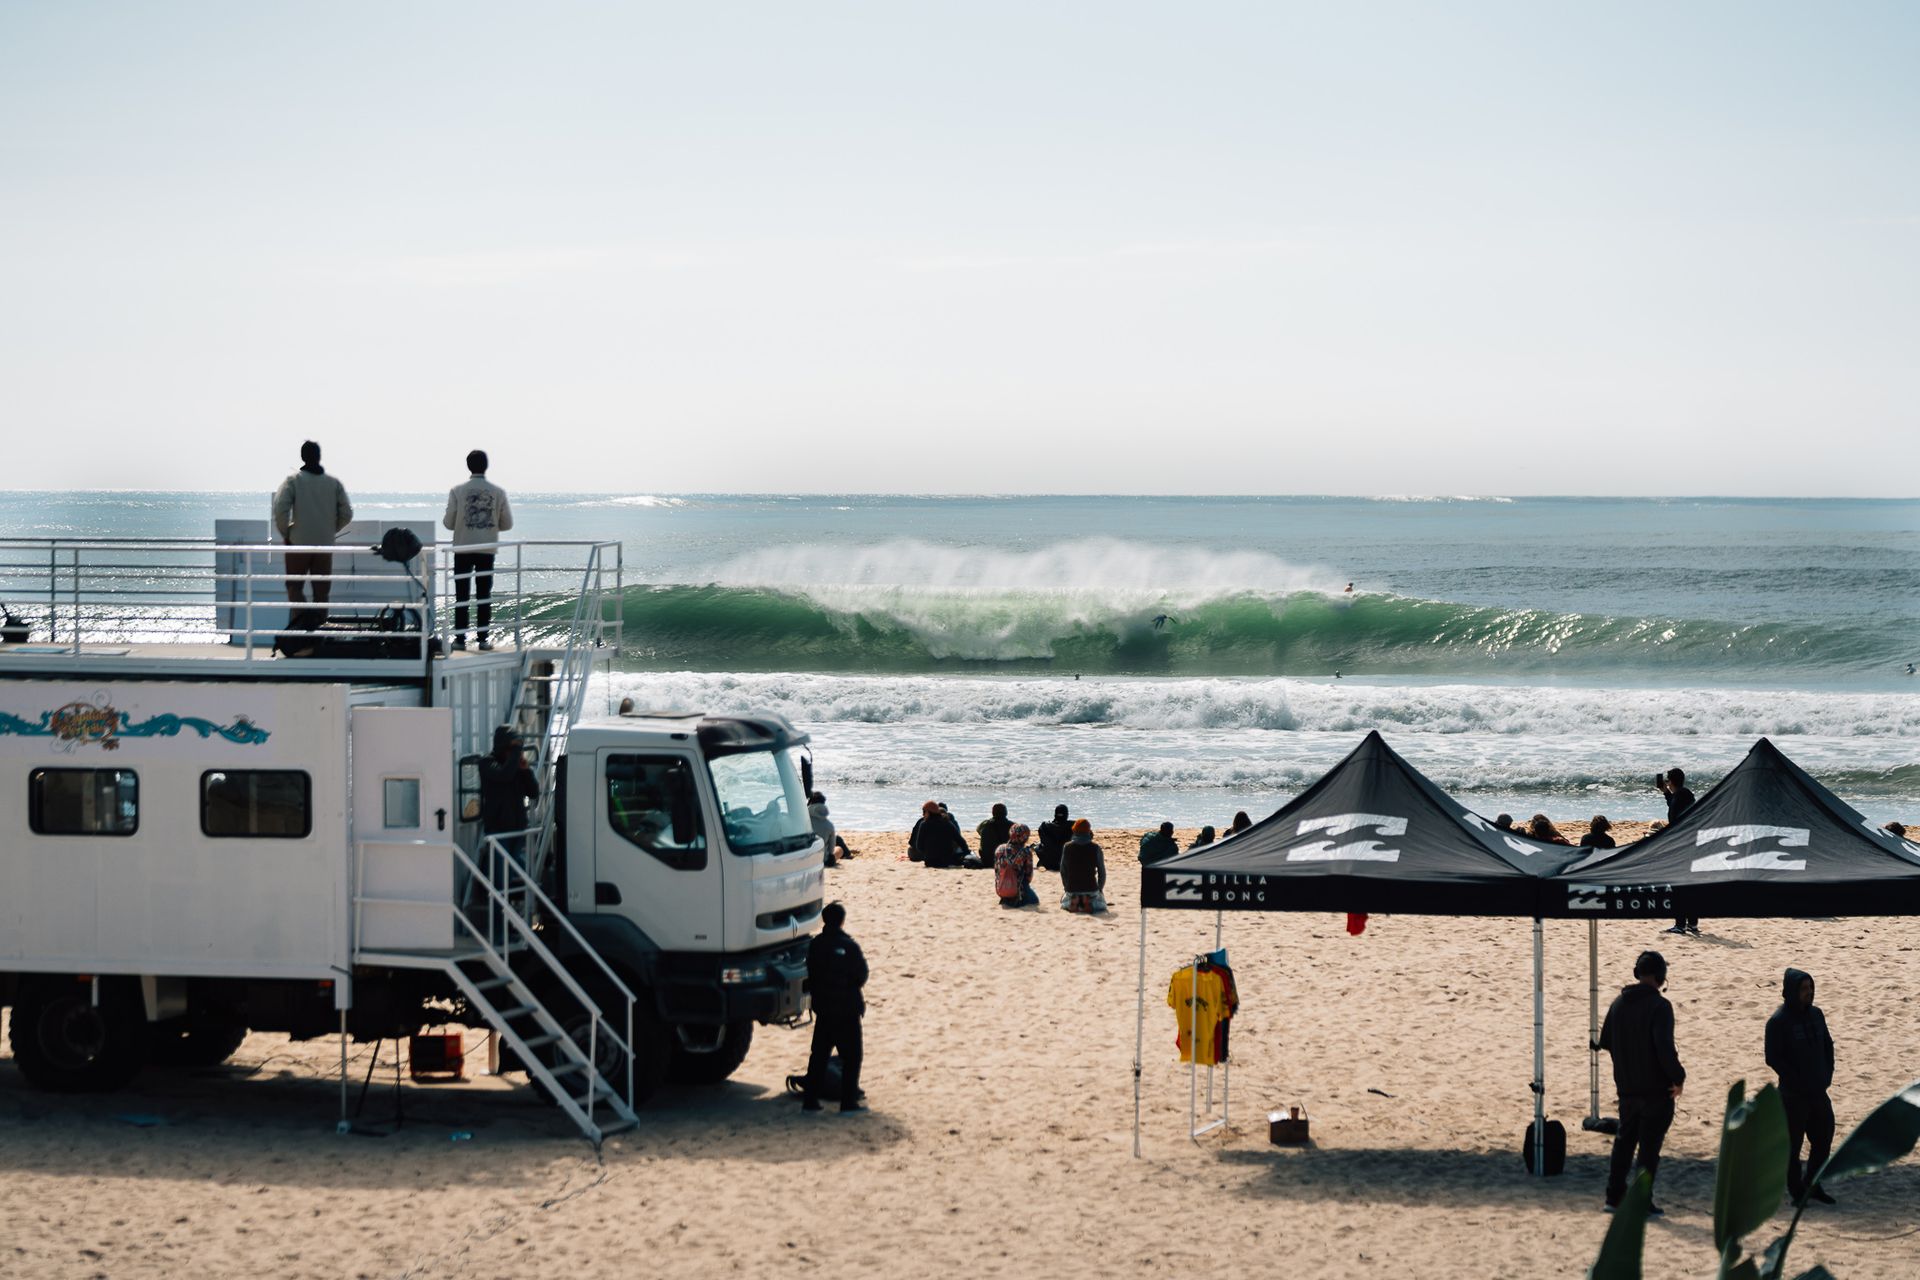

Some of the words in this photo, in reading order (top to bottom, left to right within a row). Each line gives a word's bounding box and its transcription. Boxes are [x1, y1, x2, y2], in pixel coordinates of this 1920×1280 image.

[1209, 874, 1267, 885] BILLA
[1212, 891, 1265, 901] BONG
[1616, 899, 1671, 909] BONG
